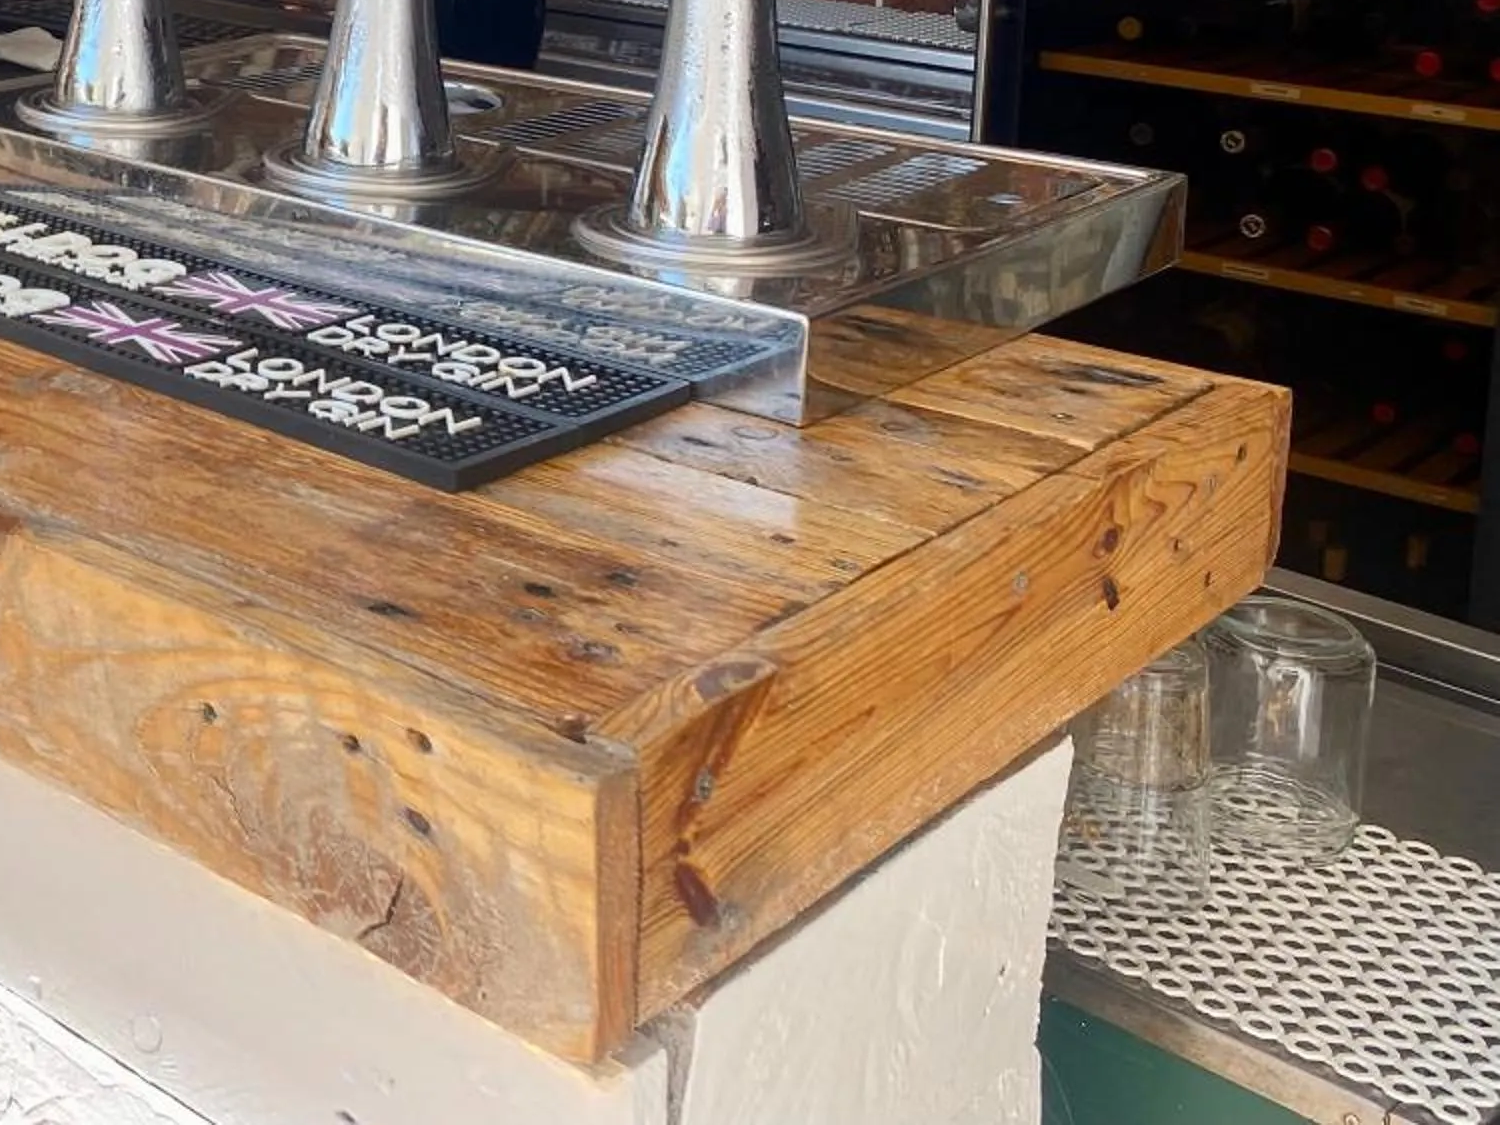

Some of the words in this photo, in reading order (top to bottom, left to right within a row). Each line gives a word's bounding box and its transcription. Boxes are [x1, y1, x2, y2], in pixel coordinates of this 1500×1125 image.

[225, 347, 482, 436] LONDON
[307, 325, 436, 365] DRY
[431, 361, 541, 399] GIN
[346, 315, 597, 393] LONDON
[184, 360, 311, 401] DRY
[308, 398, 421, 439] GIN
